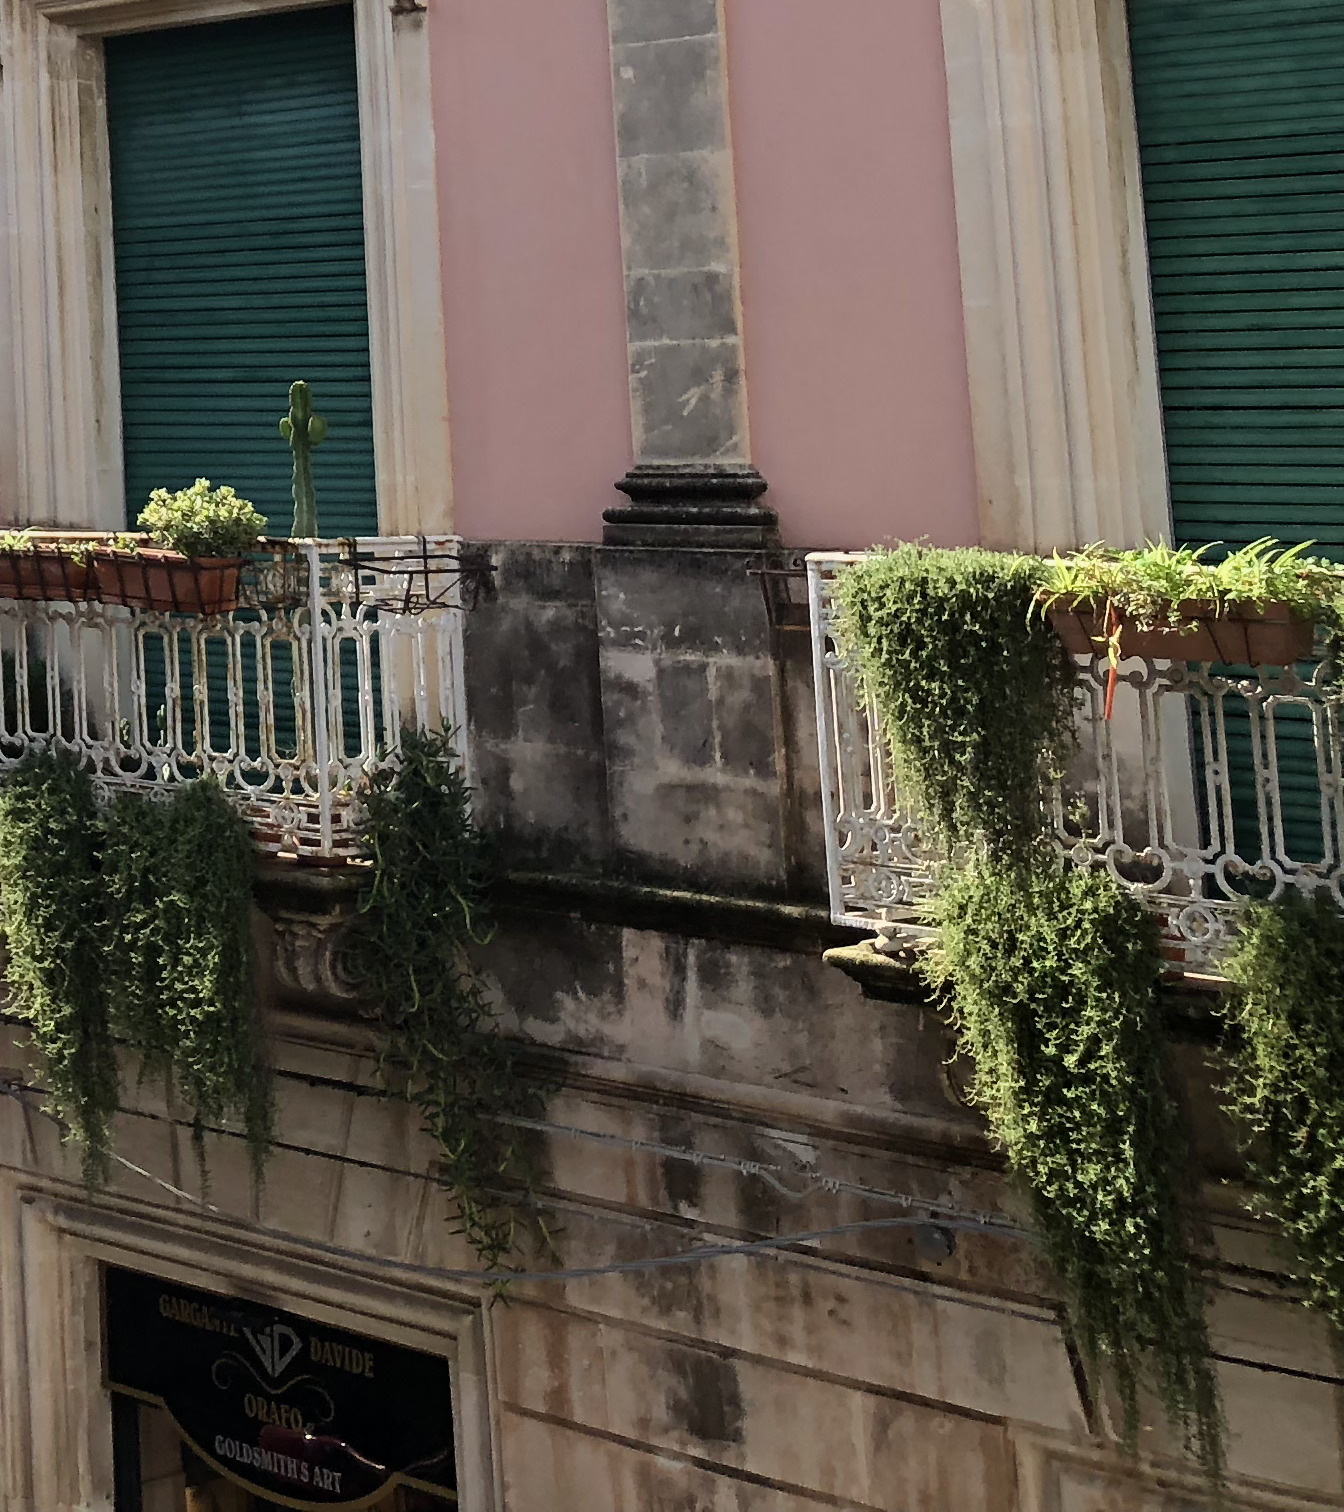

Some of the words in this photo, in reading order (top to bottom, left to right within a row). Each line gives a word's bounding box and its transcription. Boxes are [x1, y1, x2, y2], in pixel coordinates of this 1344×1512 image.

[310, 1335, 376, 1379] DAVIDE
[243, 1393, 303, 1432] ORAFO
[214, 1434, 310, 1483] GOLDSMITH'S
[312, 1465, 342, 1494] ART
